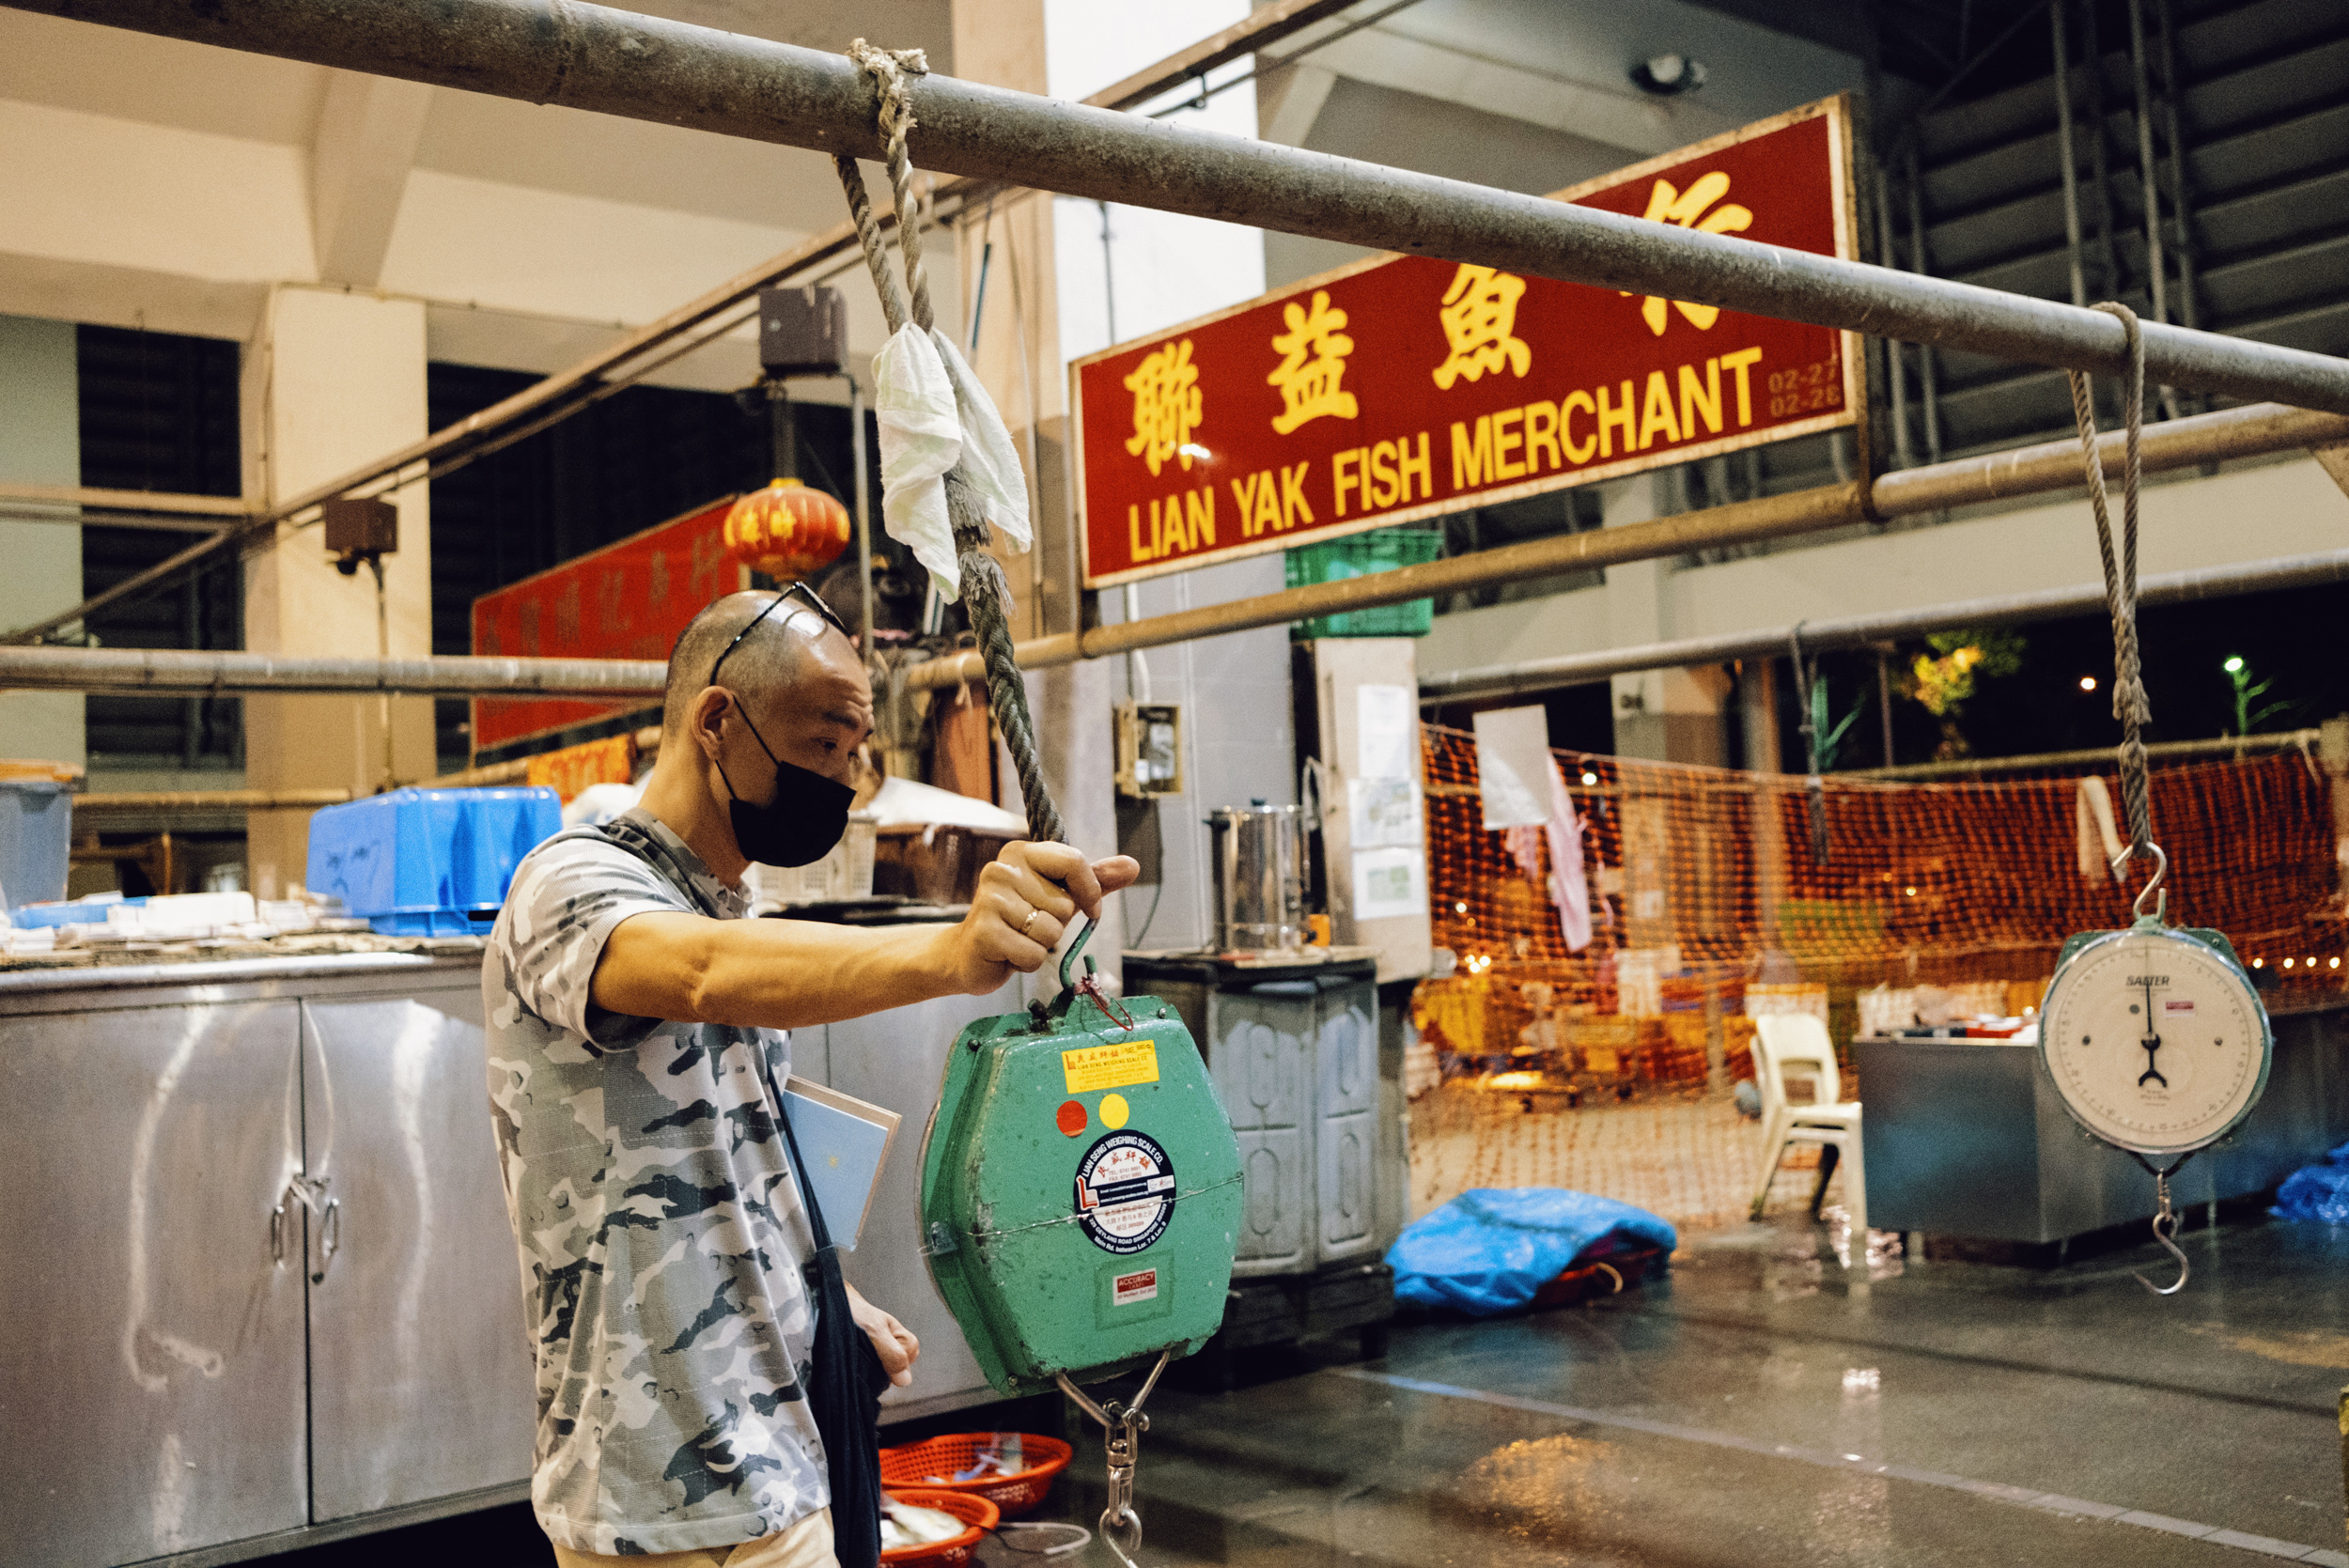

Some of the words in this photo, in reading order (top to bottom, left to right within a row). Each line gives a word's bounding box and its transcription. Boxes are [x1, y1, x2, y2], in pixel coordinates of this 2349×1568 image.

[1128, 481, 1216, 565] LIAN
[1230, 458, 1315, 539] YAK
[1331, 430, 1432, 518] FISH
[1449, 345, 1763, 492] MERCHANT
[1103, 1059, 1126, 1067] WEIGHING
[1081, 1160, 1095, 1178] LIAN
[1090, 1143, 1107, 1162] SENG
[1105, 1135, 1138, 1149] WEIGHING
[1137, 1138, 1157, 1156] SCALE
[1153, 1152, 1164, 1166] CO.
[1118, 1273, 1155, 1287] ACCURACY
